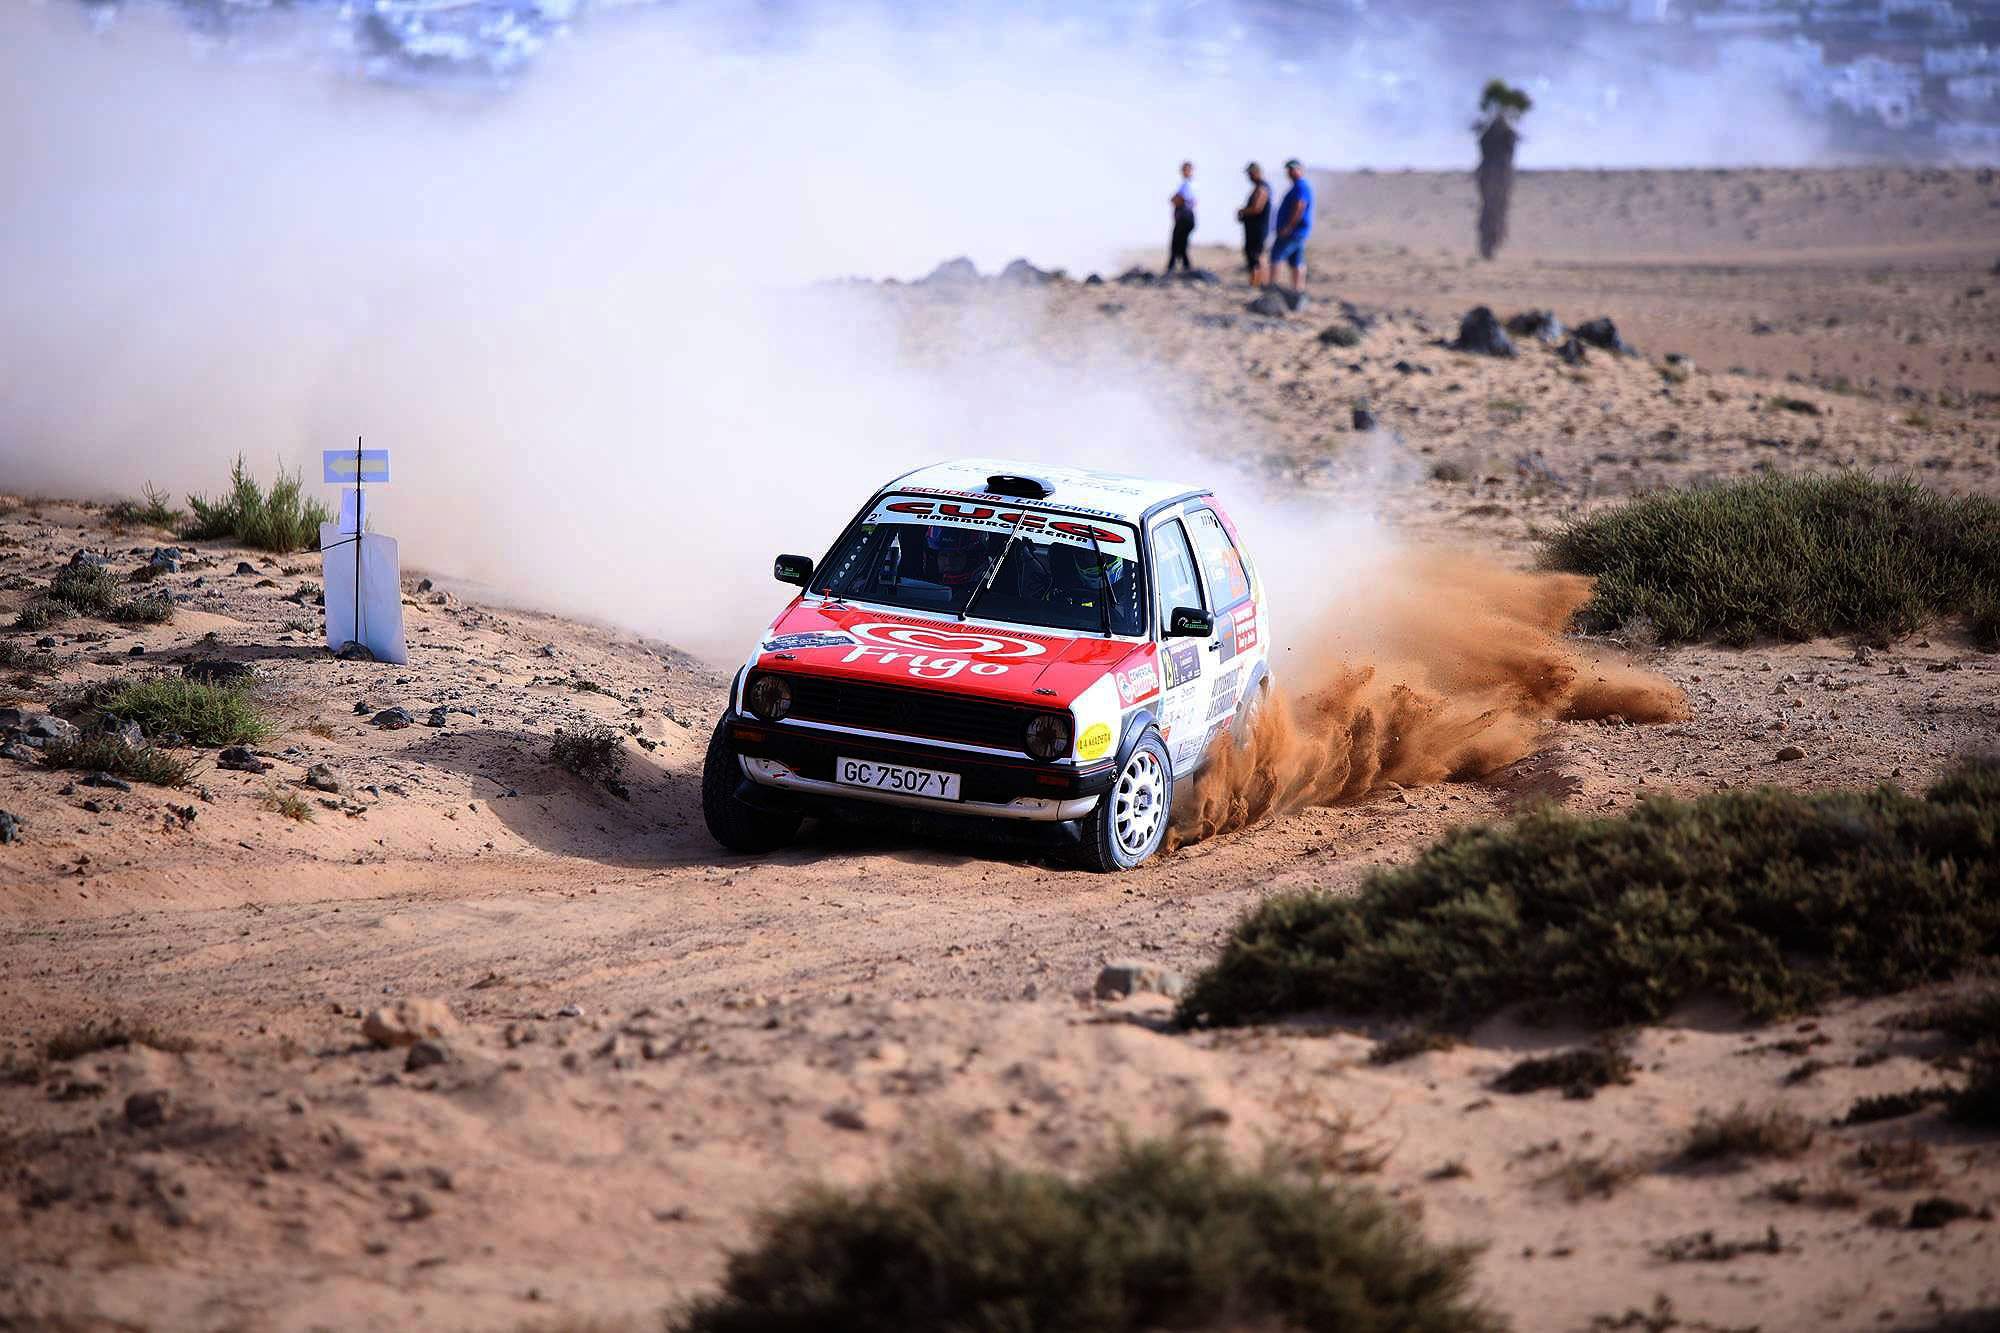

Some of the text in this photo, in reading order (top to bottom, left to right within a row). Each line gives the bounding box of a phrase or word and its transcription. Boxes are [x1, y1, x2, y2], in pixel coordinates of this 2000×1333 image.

[900, 486, 1128, 520] ESCUDERIA LANZAROTE
[886, 502, 1126, 544] CUCO
[841, 644, 1009, 679] Frigo
[844, 762, 950, 795] GC 7507 Y
